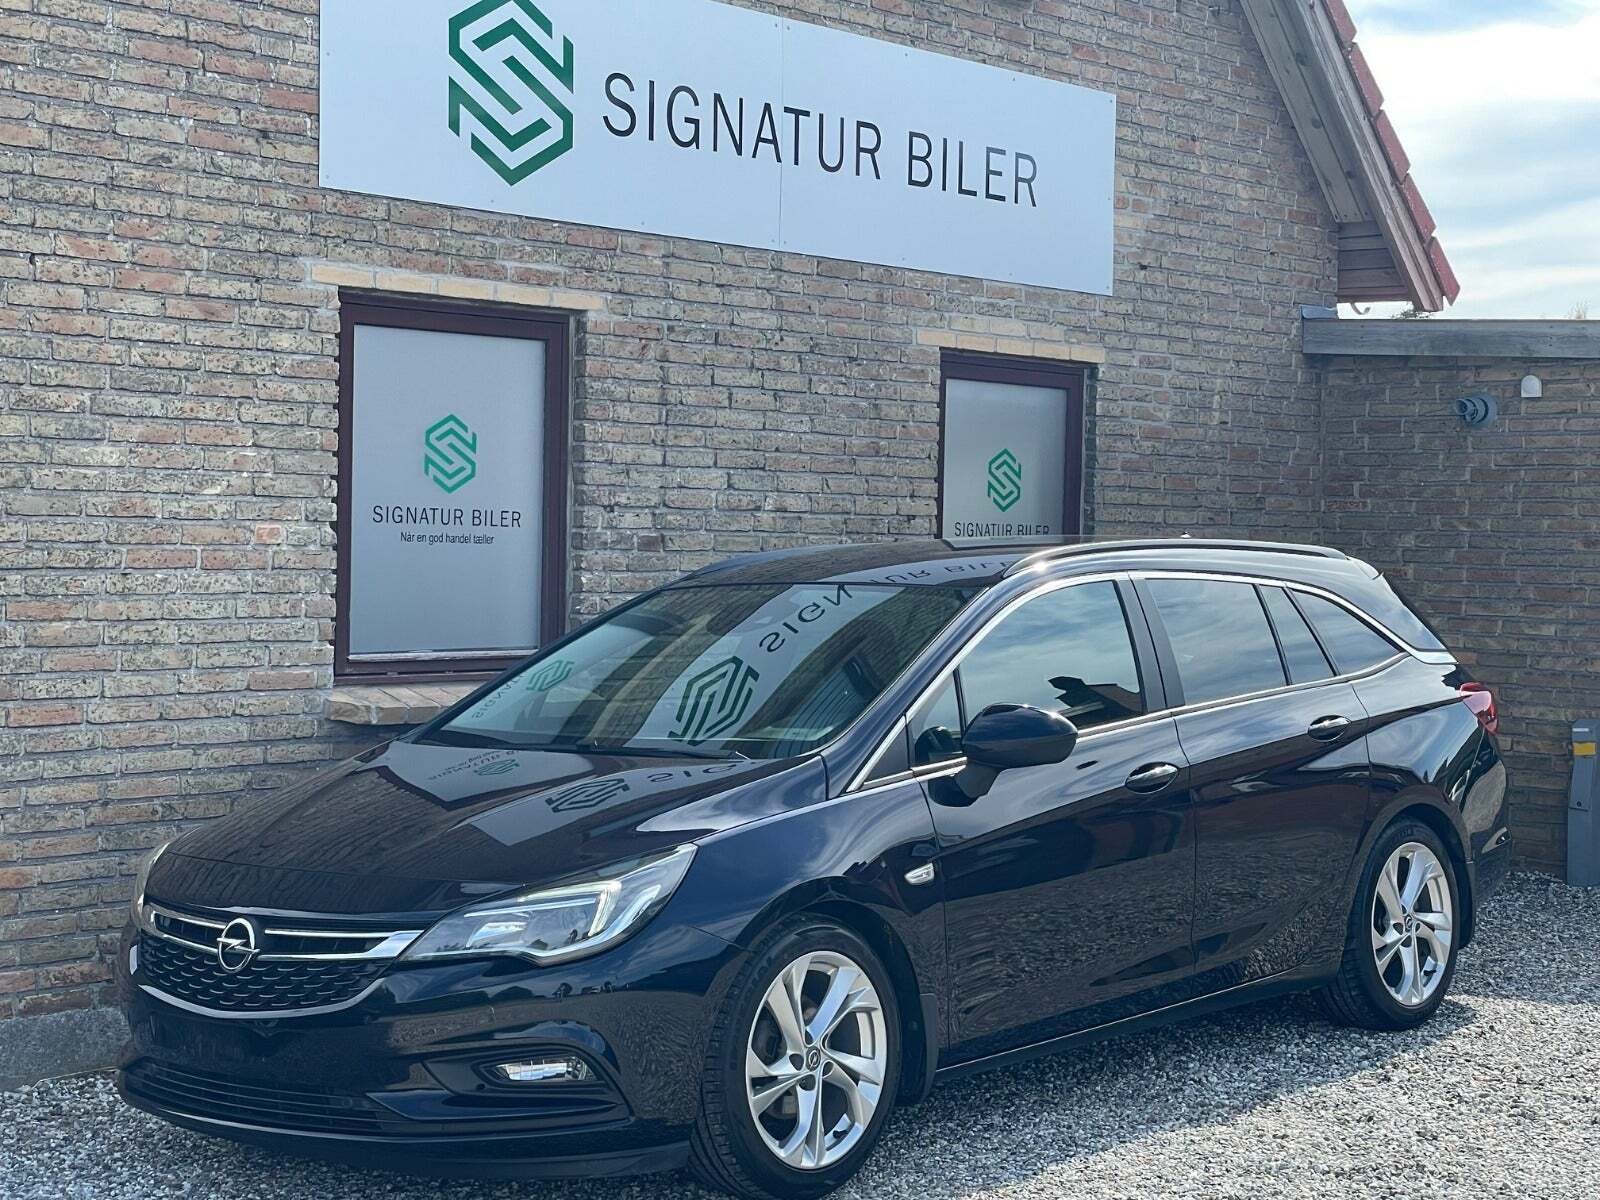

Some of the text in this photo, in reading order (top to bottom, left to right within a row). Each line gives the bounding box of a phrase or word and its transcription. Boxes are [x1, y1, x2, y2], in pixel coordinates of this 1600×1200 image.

[602, 72, 1038, 208] SIGNATUR BILER
[372, 505, 522, 528] SIGNATUR BILER
[400, 532, 495, 545] Når en god handel tæller
[954, 522, 1050, 537] SIGNATUR BILER
